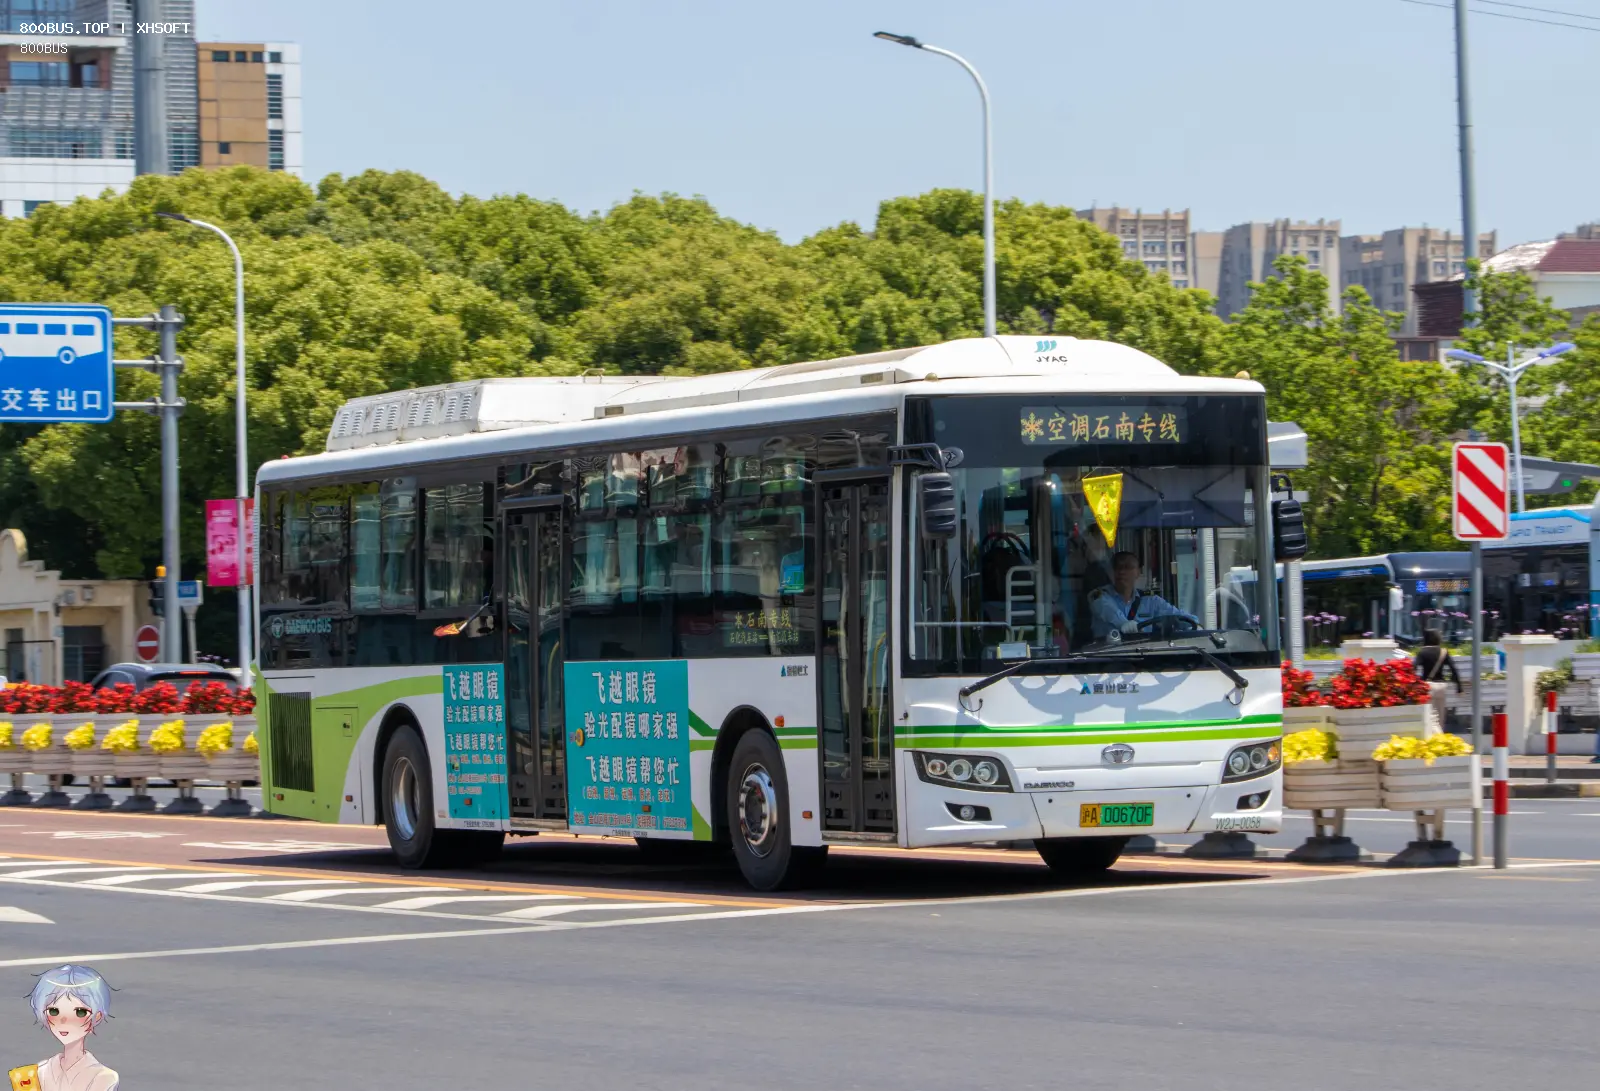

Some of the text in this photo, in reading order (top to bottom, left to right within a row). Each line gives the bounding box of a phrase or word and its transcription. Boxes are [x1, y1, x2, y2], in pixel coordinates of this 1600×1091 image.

[1036, 355, 1068, 363] JYAC
[1, 387, 103, 412] 交车出口
[1047, 411, 1180, 443] 空调石南专线
[317, 618, 332, 633] BUS
[745, 607, 792, 629] 石南专线
[445, 670, 500, 701] 飞越眼镜
[592, 670, 657, 704] 飞越眼镜
[1092, 682, 1140, 695] 金山巴士
[446, 705, 503, 723] 验光配镜哪家强
[584, 711, 679, 740] 验光配镜哪家强
[447, 733, 504, 751] 飞越眼镜帮您忙
[586, 755, 680, 786] 飞越眼镜帮您忙
[1023, 780, 1075, 789] DAEWOO
